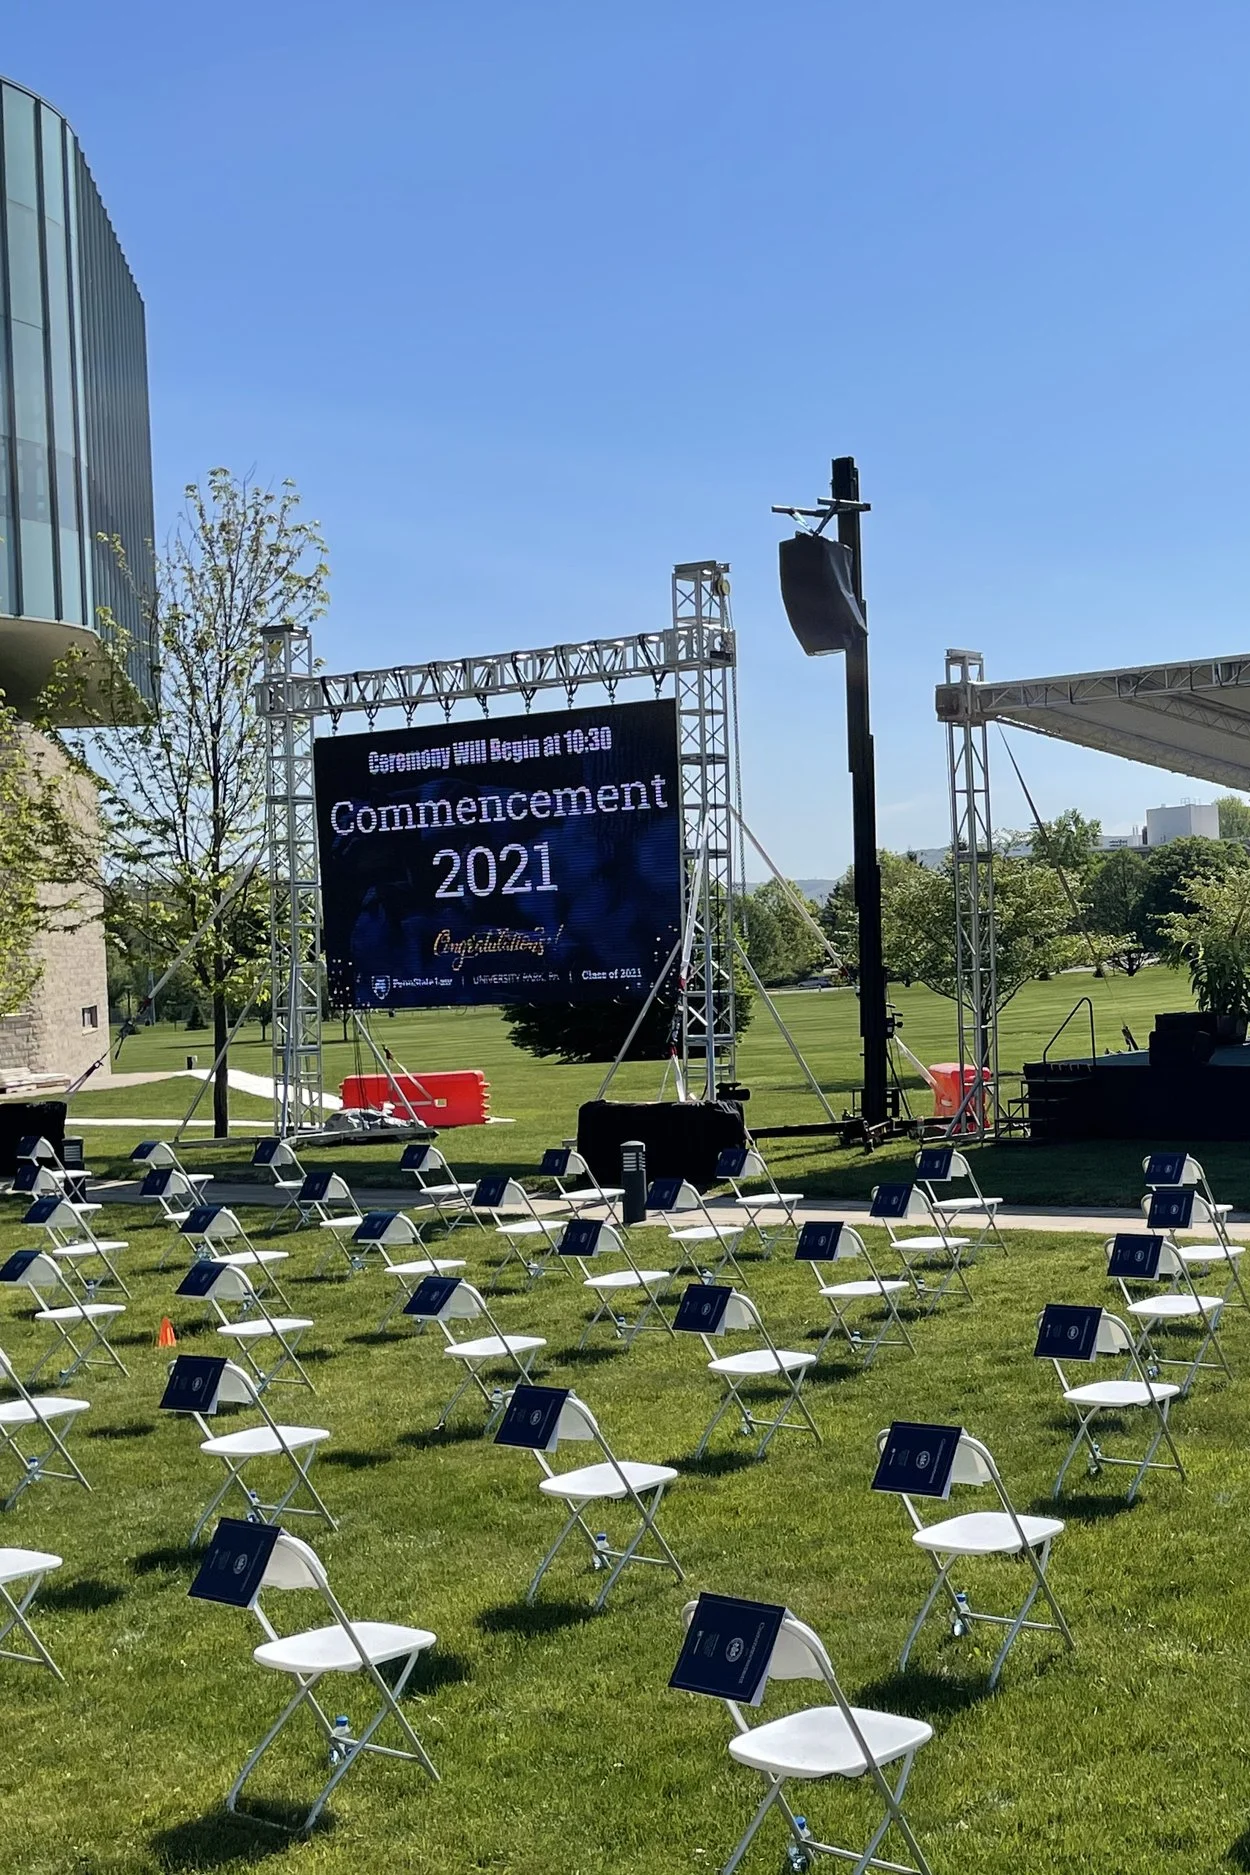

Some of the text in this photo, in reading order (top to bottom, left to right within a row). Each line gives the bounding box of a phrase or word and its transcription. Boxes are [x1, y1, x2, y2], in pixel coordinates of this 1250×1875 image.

[368, 726, 612, 775] Ceremony Will Begin at 10:30
[330, 774, 669, 836] Commencement
[432, 841, 558, 898] 2021
[608, 968, 619, 979] of
[620, 967, 642, 979] 2021
